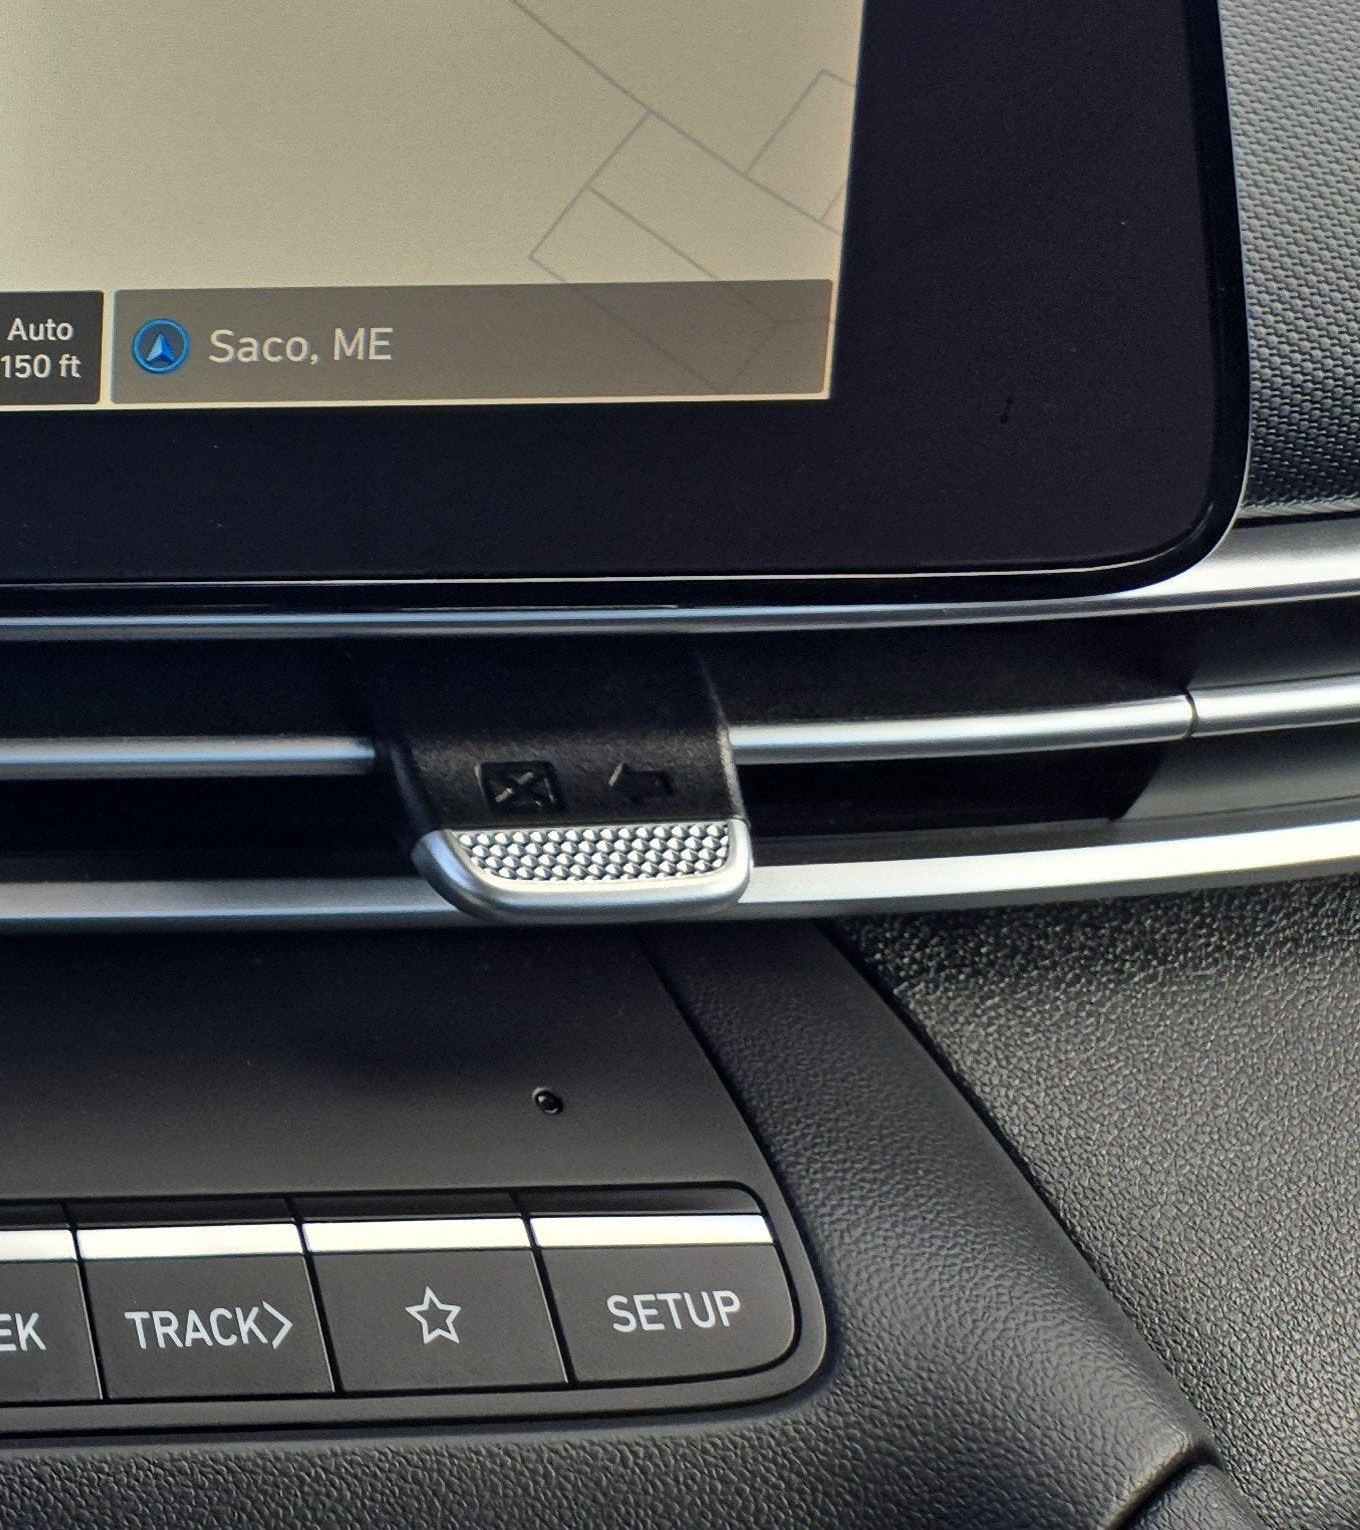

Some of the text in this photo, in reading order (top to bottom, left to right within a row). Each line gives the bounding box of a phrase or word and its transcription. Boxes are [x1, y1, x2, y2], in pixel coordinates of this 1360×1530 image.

[6, 317, 74, 342] Auto
[207, 326, 395, 366] Saco, ME
[0, 353, 81, 379] 150 ft
[608, 1289, 743, 1334] SETUP
